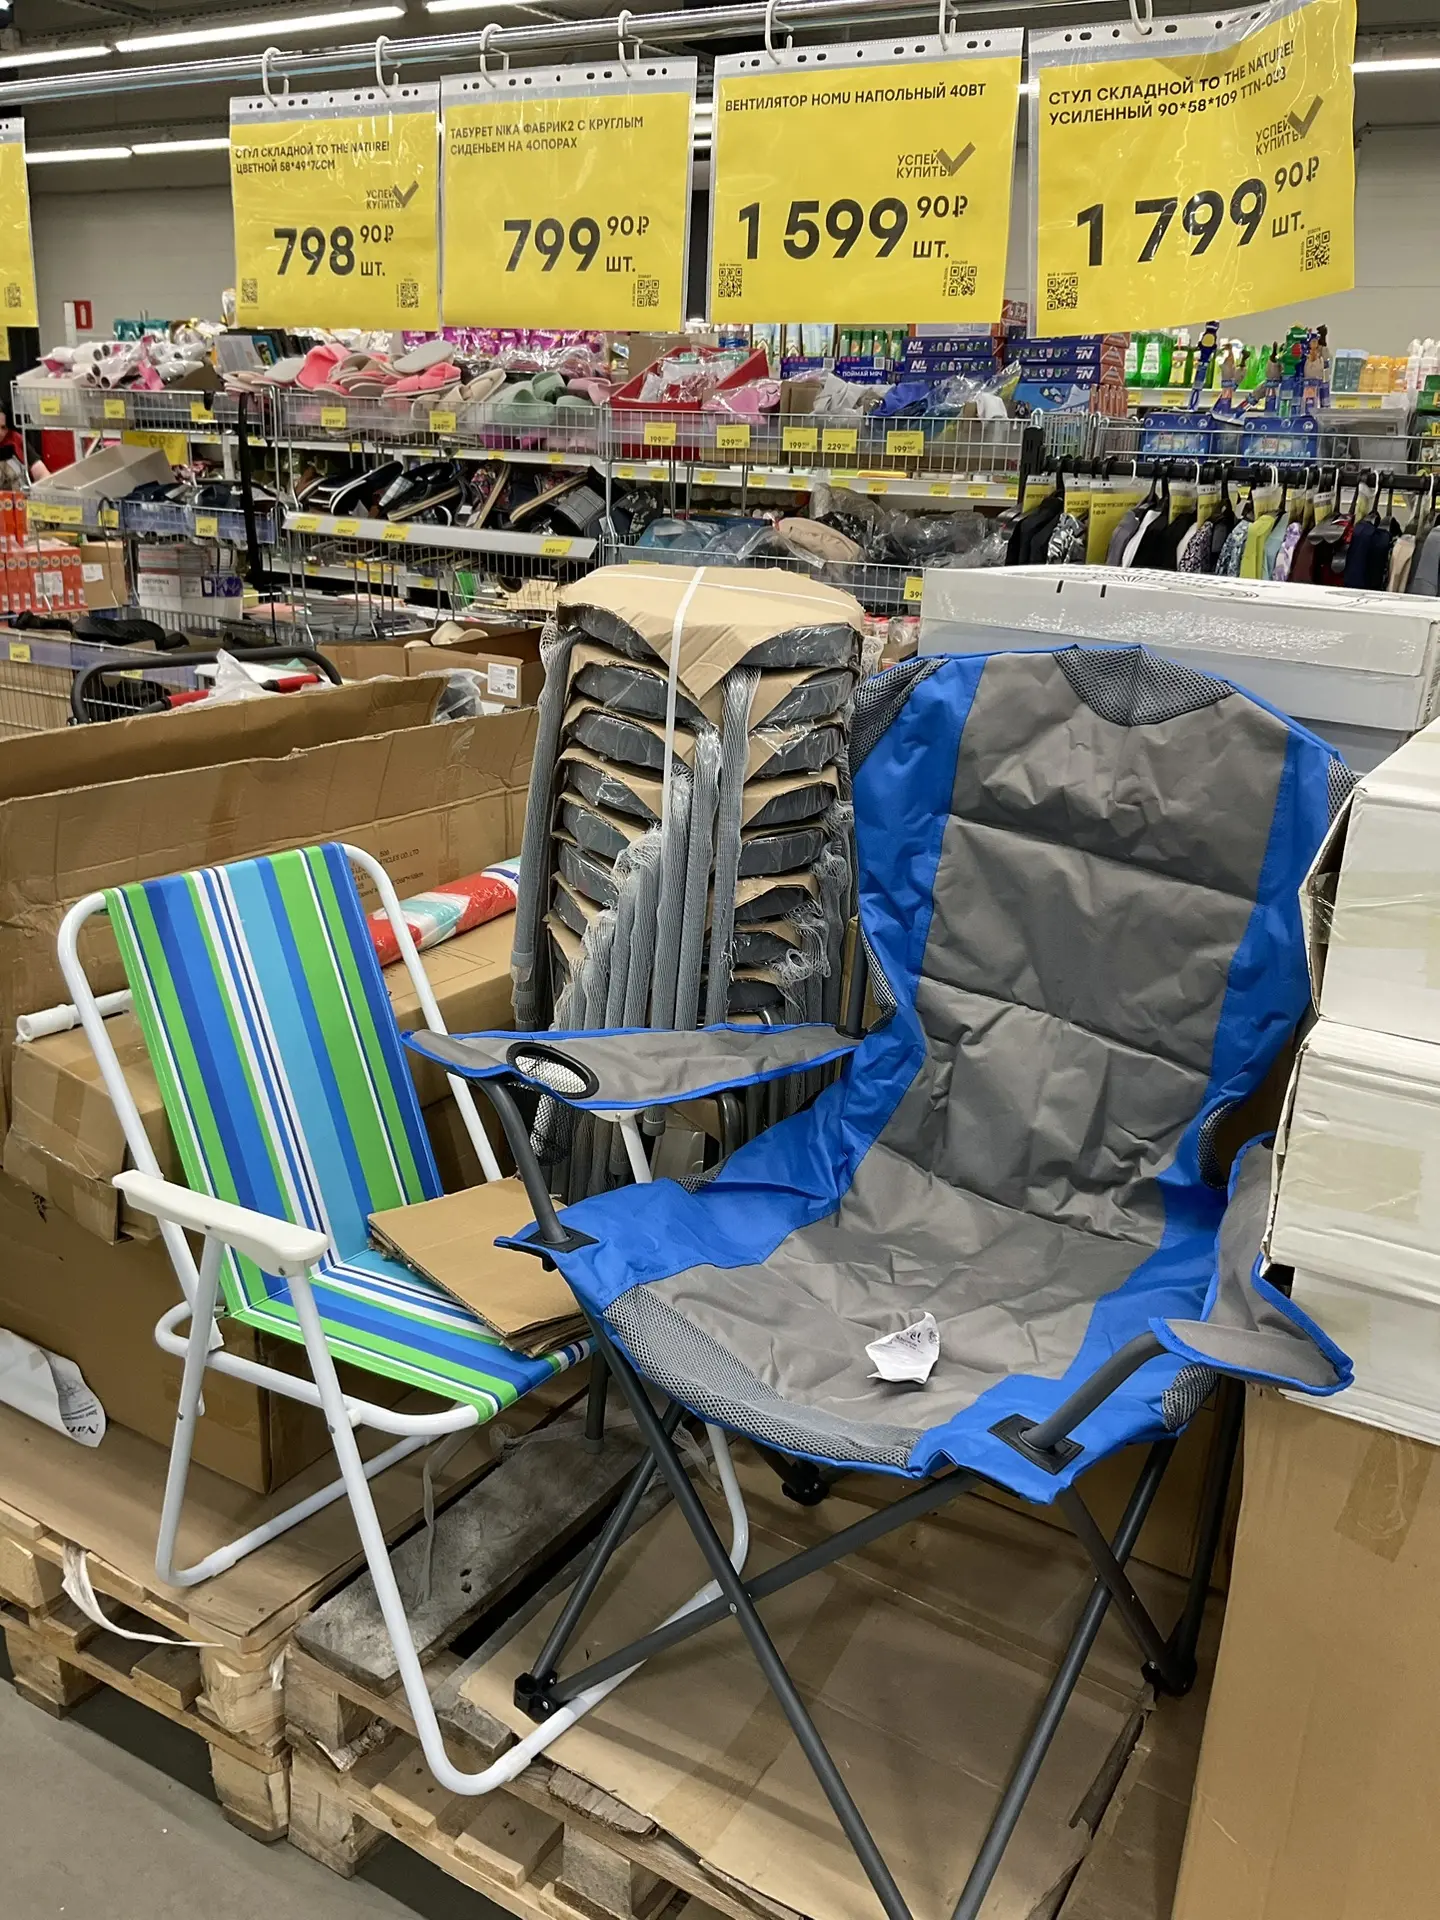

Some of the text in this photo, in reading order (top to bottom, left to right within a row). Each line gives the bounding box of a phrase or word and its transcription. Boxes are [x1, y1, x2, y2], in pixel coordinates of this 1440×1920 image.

[1049, 39, 1294, 106] СТУЛ СКЛАДНОЙ TO THE NATURE!
[725, 82, 987, 112] ВЕНТИЛЯТОР HOMU НАПОЛЬНЫЙ 40ВТ
[1049, 100, 1153, 125] УСИЛЕННЫЙ
[450, 116, 644, 139] ТАБУРЕТ NIKA ФАБРИК2 С КРУГЛЫМ
[235, 147, 259, 159] СТУЛ
[260, 142, 314, 157] СКЛАДНОЙ
[330, 142, 348, 154] THE
[450, 137, 577, 156] СИДЕНЬЕМ НА 4ОПОРАХ
[897, 149, 939, 166] УСПЕЙ
[236, 159, 278, 175] ЦВЕТНОЙ
[738, 202, 760, 260] 1
[783, 197, 909, 260] 599
[1077, 203, 1104, 267] 1
[1135, 178, 1268, 263] 799
[274, 225, 355, 276] 798
[503, 216, 601, 272] 799
[721, 438, 735, 446] 299
[789, 441, 802, 449] 199
[894, 445, 907, 453] 199
